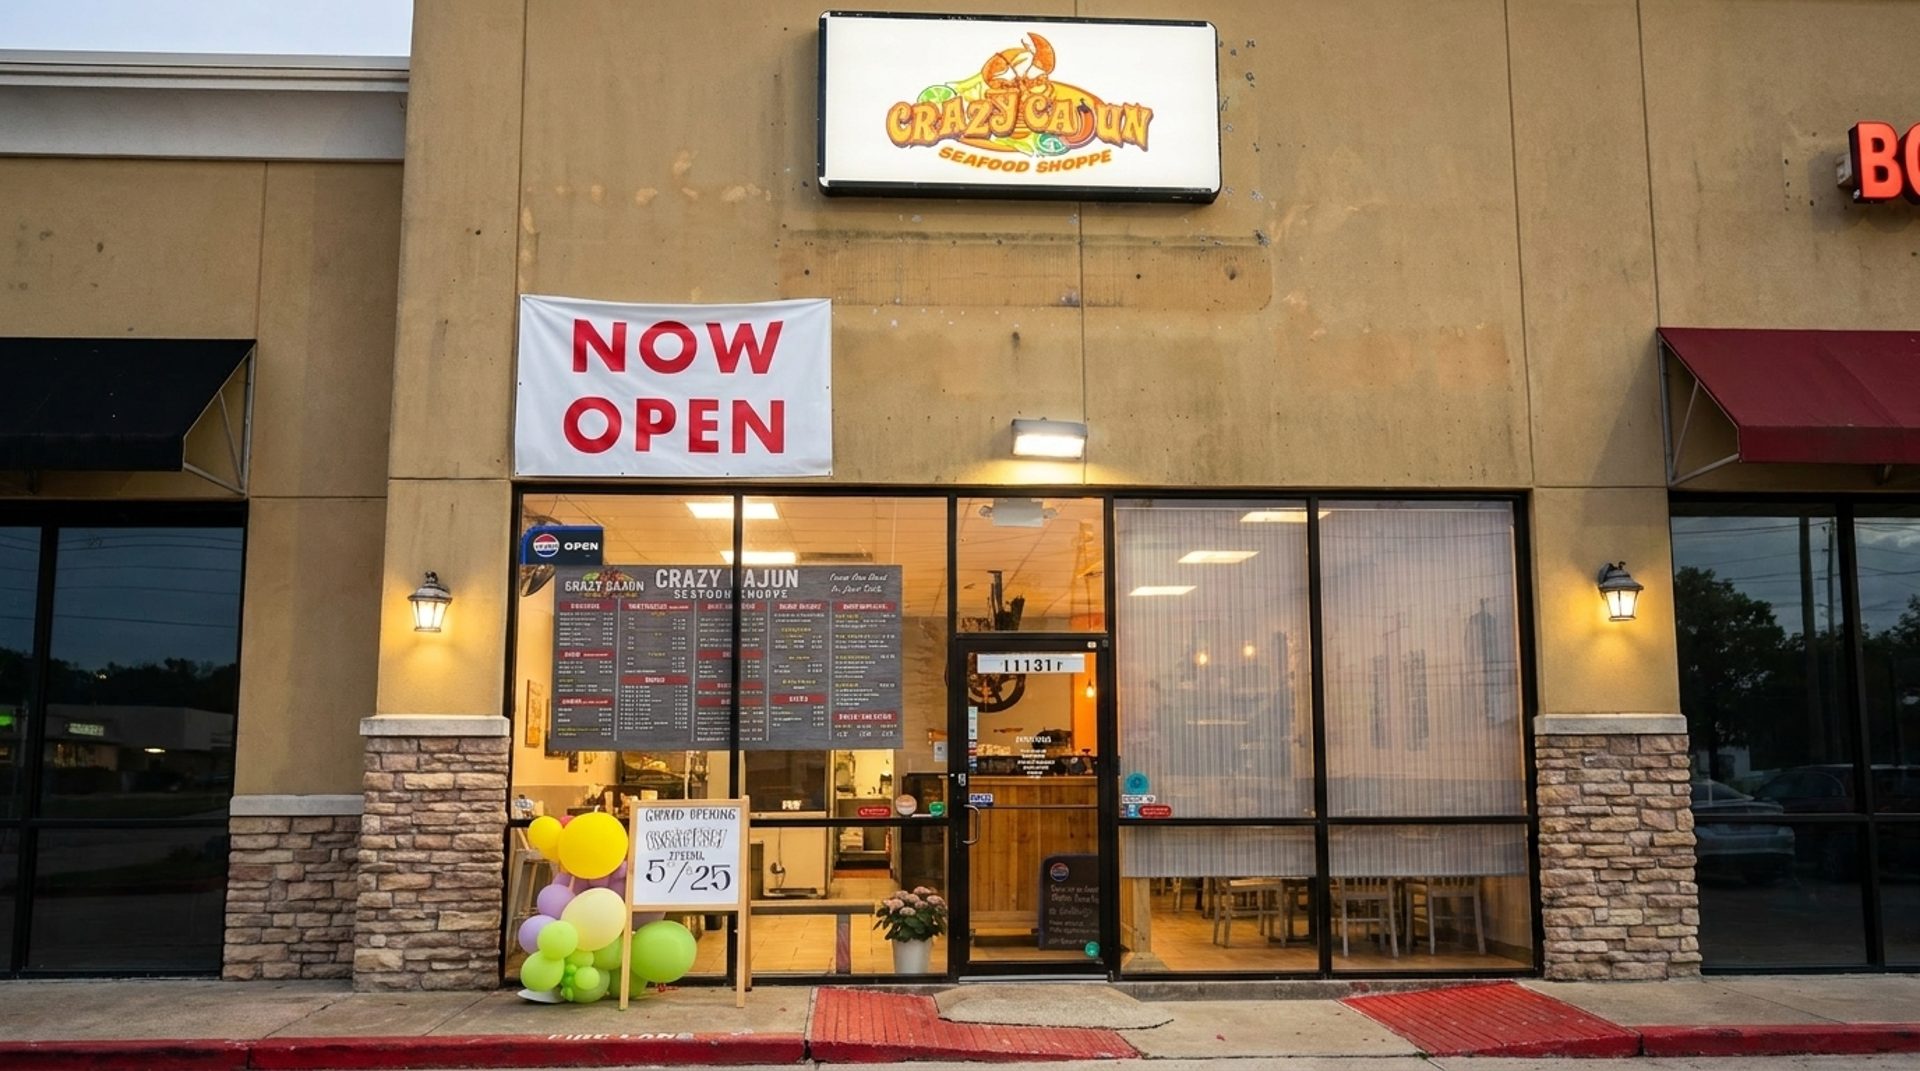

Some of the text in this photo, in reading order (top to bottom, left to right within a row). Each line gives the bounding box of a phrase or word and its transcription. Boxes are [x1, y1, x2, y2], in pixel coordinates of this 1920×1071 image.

[886, 90, 1155, 151] CRAZY CAJUN
[938, 146, 1112, 173] SEAFOOD SHOPPE
[572, 319, 784, 375] NOW
[563, 396, 785, 454] OPEN
[655, 569, 799, 589] CRAZY AJUN
